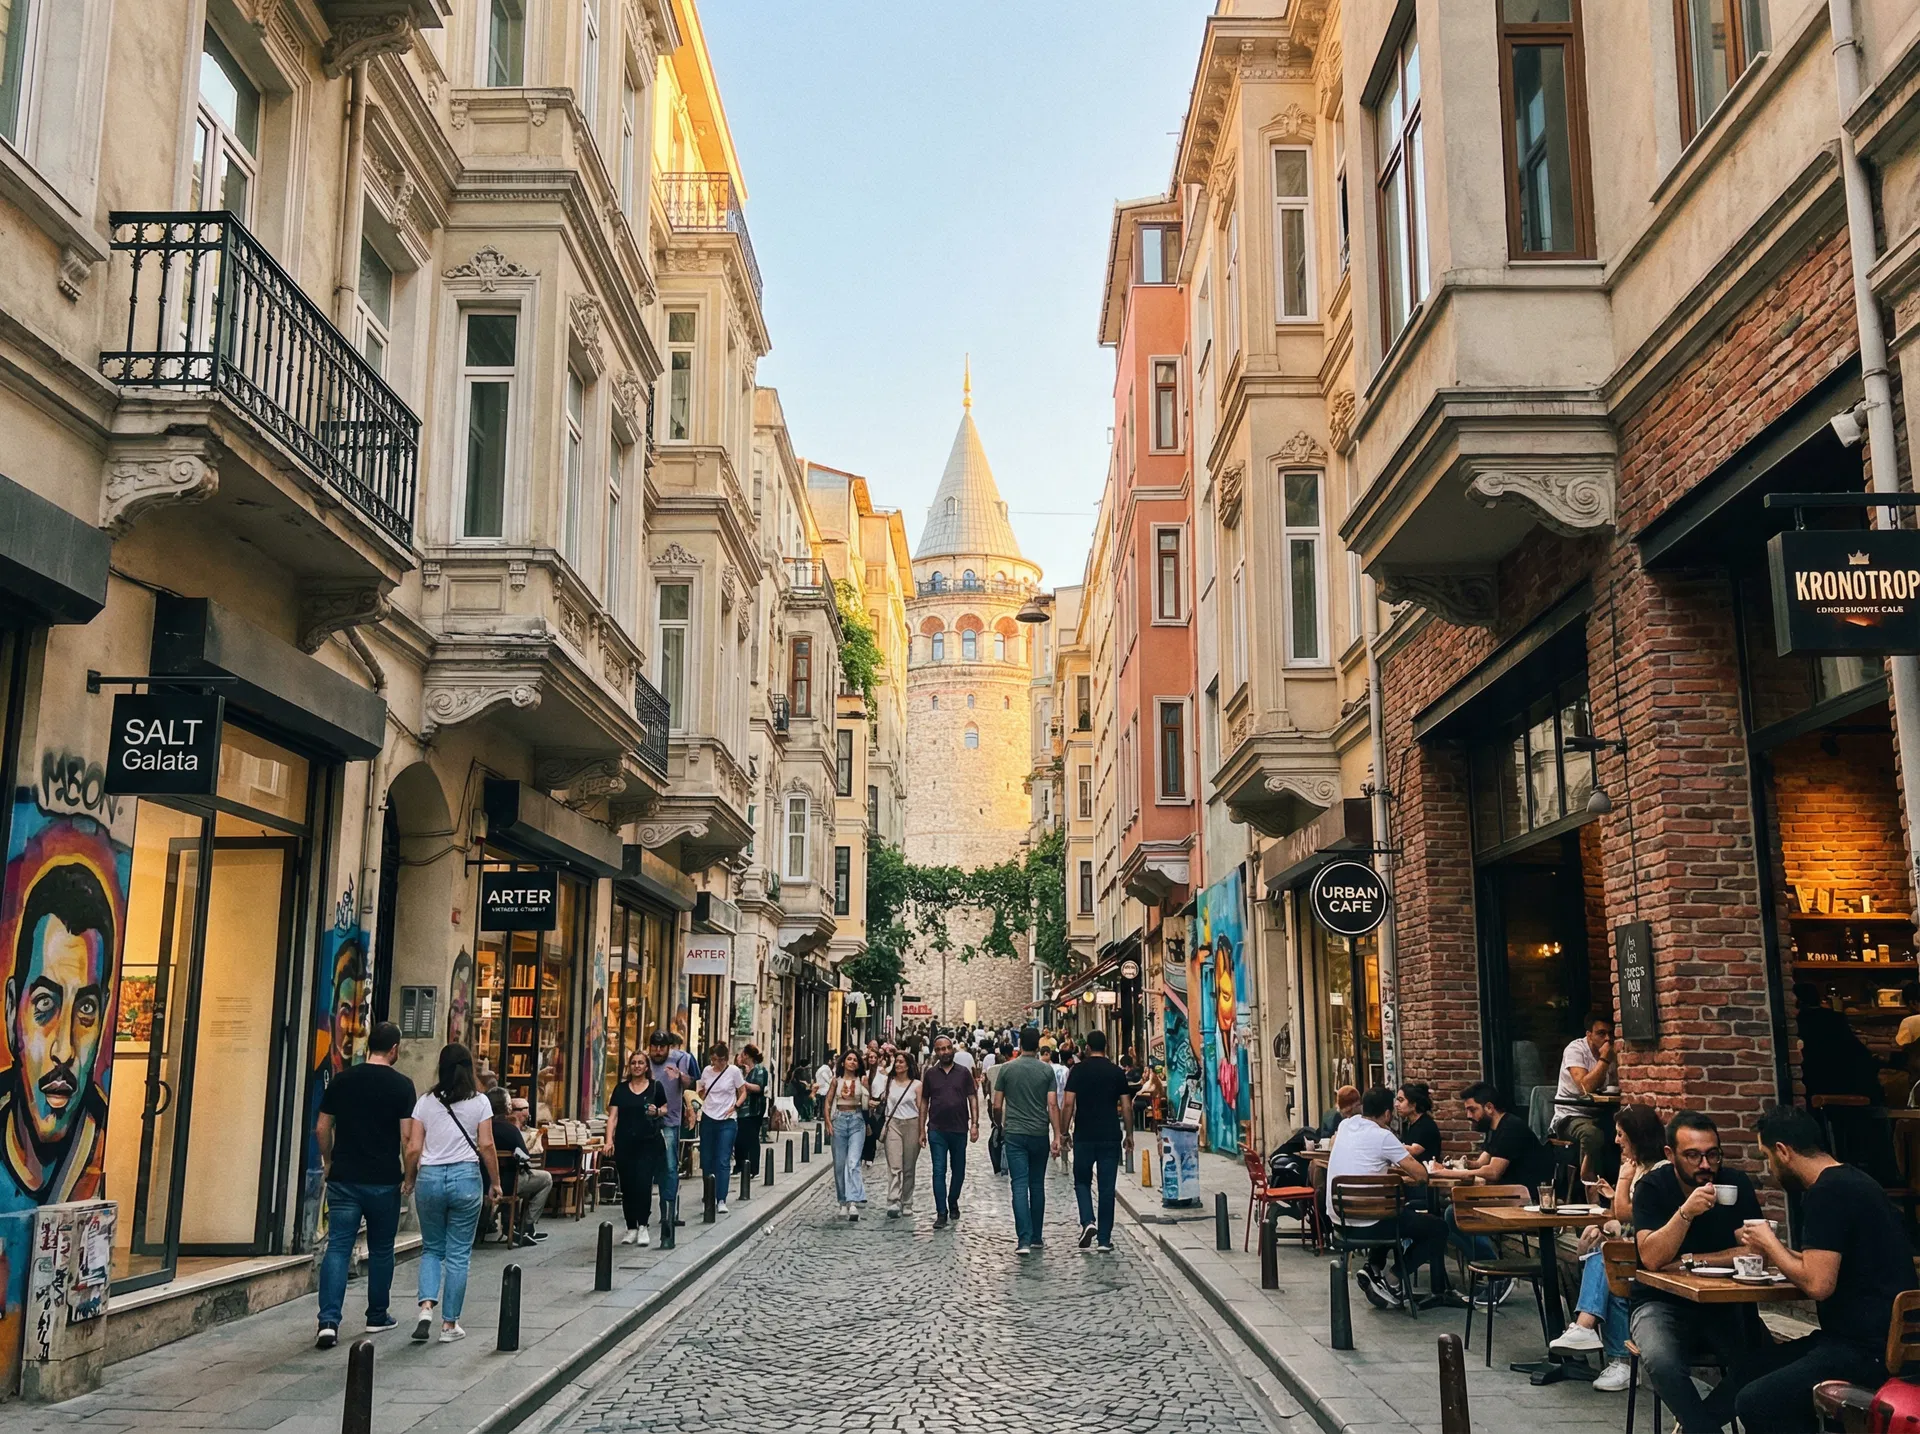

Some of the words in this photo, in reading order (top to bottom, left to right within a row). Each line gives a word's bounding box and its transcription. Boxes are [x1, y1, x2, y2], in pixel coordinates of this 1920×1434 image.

[1795, 570, 1920, 601] KRONOTROP
[123, 719, 203, 746] SALT
[122, 749, 199, 771] Galata
[487, 889, 552, 904] ARTER
[1322, 886, 1378, 899] URBAN
[1329, 900, 1373, 913] CAFE
[686, 949, 726, 960] ARTER
